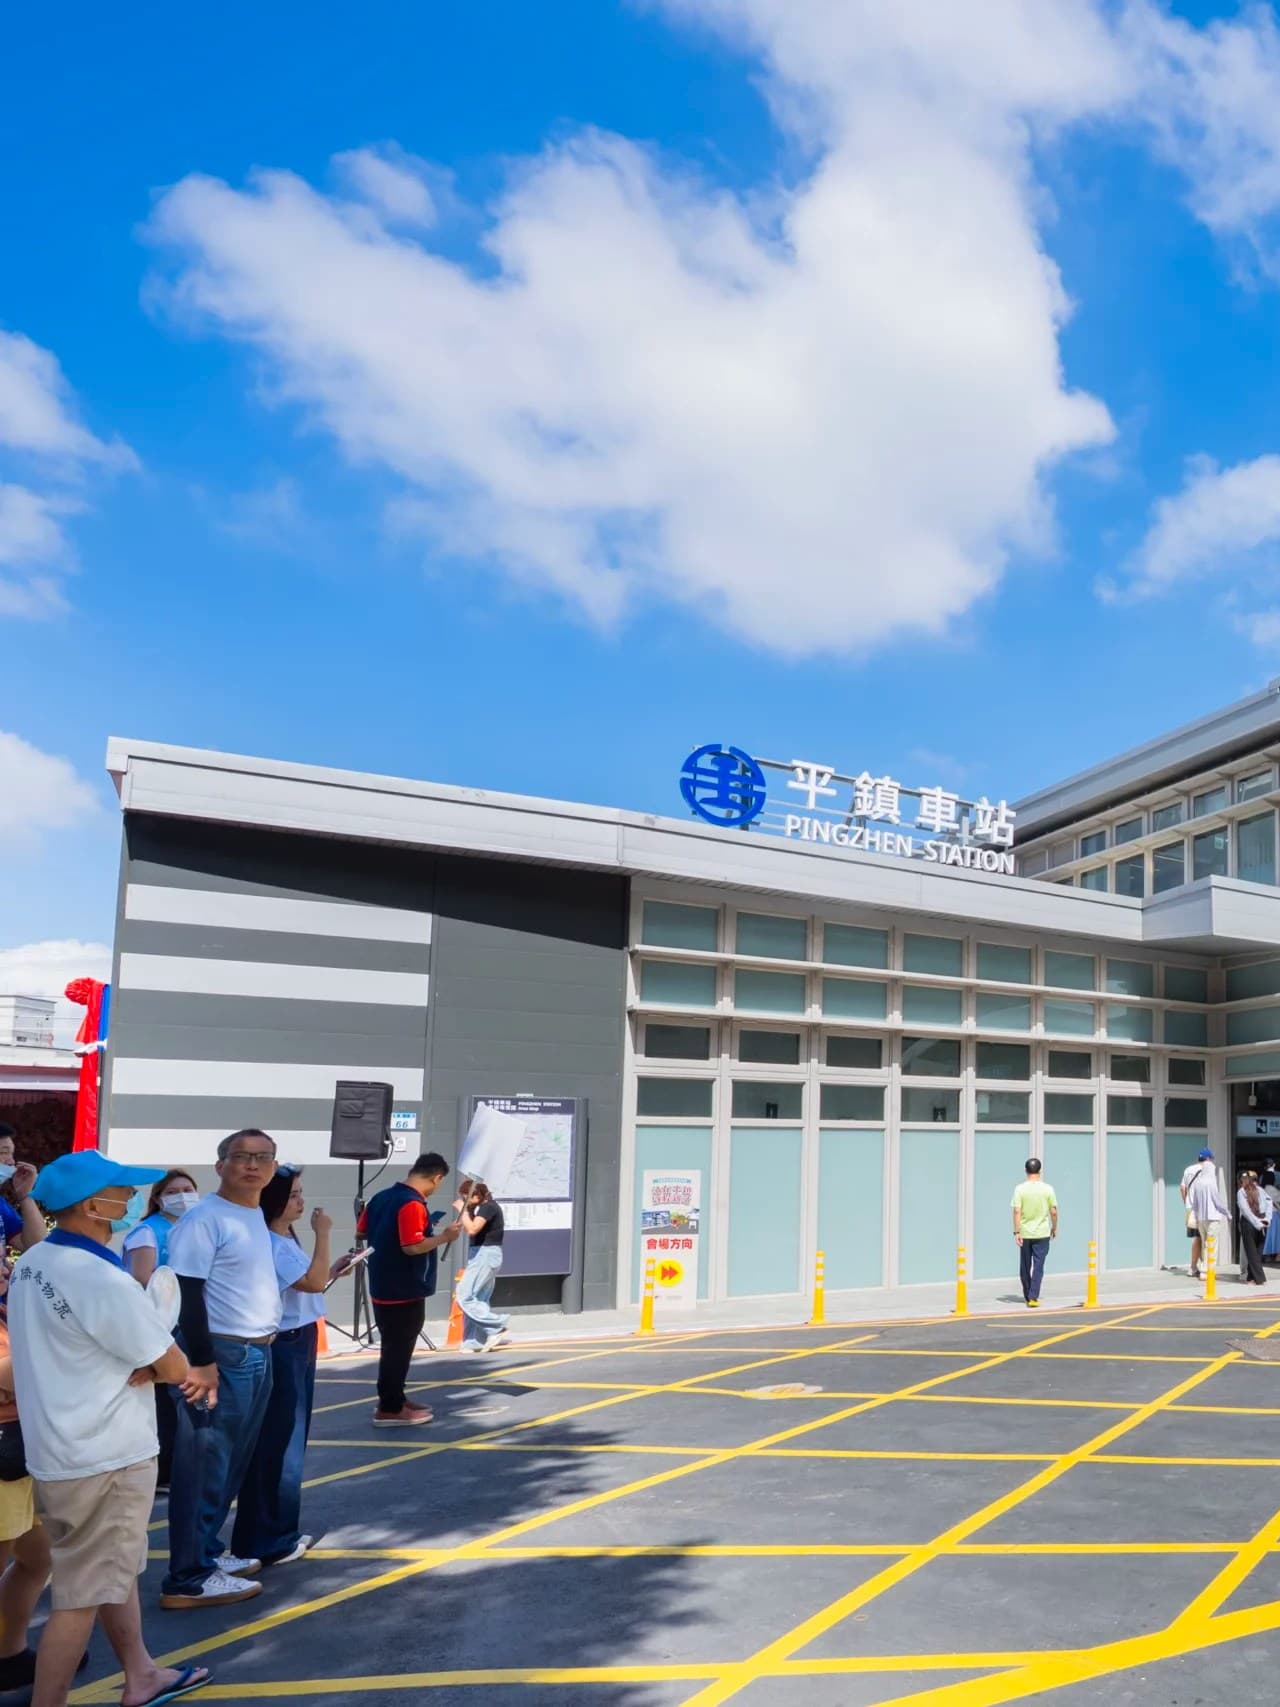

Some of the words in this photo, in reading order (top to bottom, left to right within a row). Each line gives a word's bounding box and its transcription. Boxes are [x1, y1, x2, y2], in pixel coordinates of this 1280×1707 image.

[787, 759, 1016, 847] 平鎮車站
[785, 814, 913, 858] PINGZHEN
[923, 840, 1016, 875] STATION
[396, 1120, 409, 1128] 66
[647, 1238, 693, 1250] 會場方向
